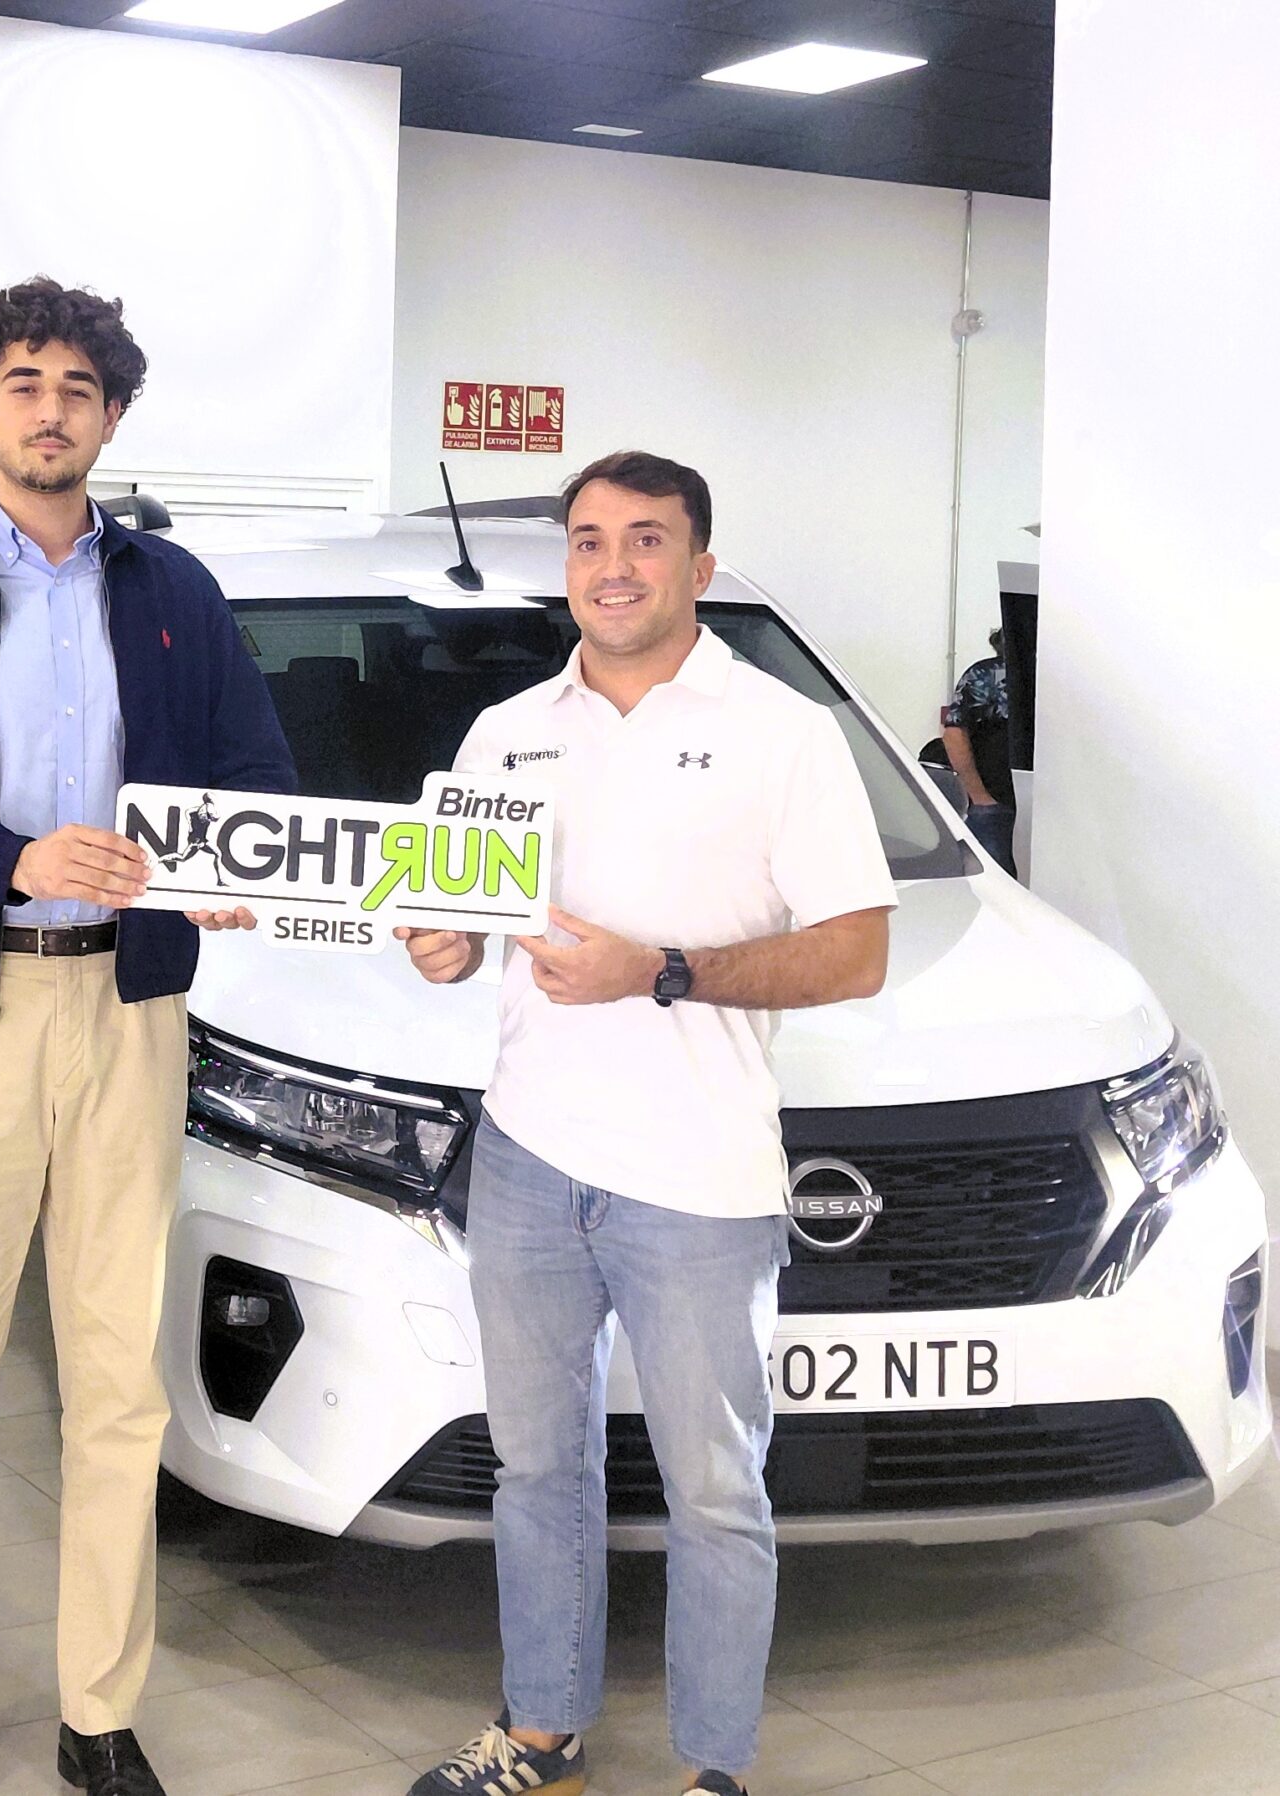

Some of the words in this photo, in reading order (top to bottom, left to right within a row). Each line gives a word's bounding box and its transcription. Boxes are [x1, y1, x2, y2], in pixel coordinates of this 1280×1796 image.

[445, 431, 478, 440] PULSADOR
[486, 437, 521, 446] EXTINTOR
[529, 435, 548, 443] BOCA
[444, 440, 453, 448] DE
[453, 441, 479, 449] ALARMA
[519, 750, 560, 762] EVENTOS
[436, 787, 545, 823] Binter
[273, 915, 374, 946] SERIES
[799, 1198, 881, 1215] ISSAN
[767, 1343, 858, 1402] 02
[884, 1339, 999, 1399] NTB
